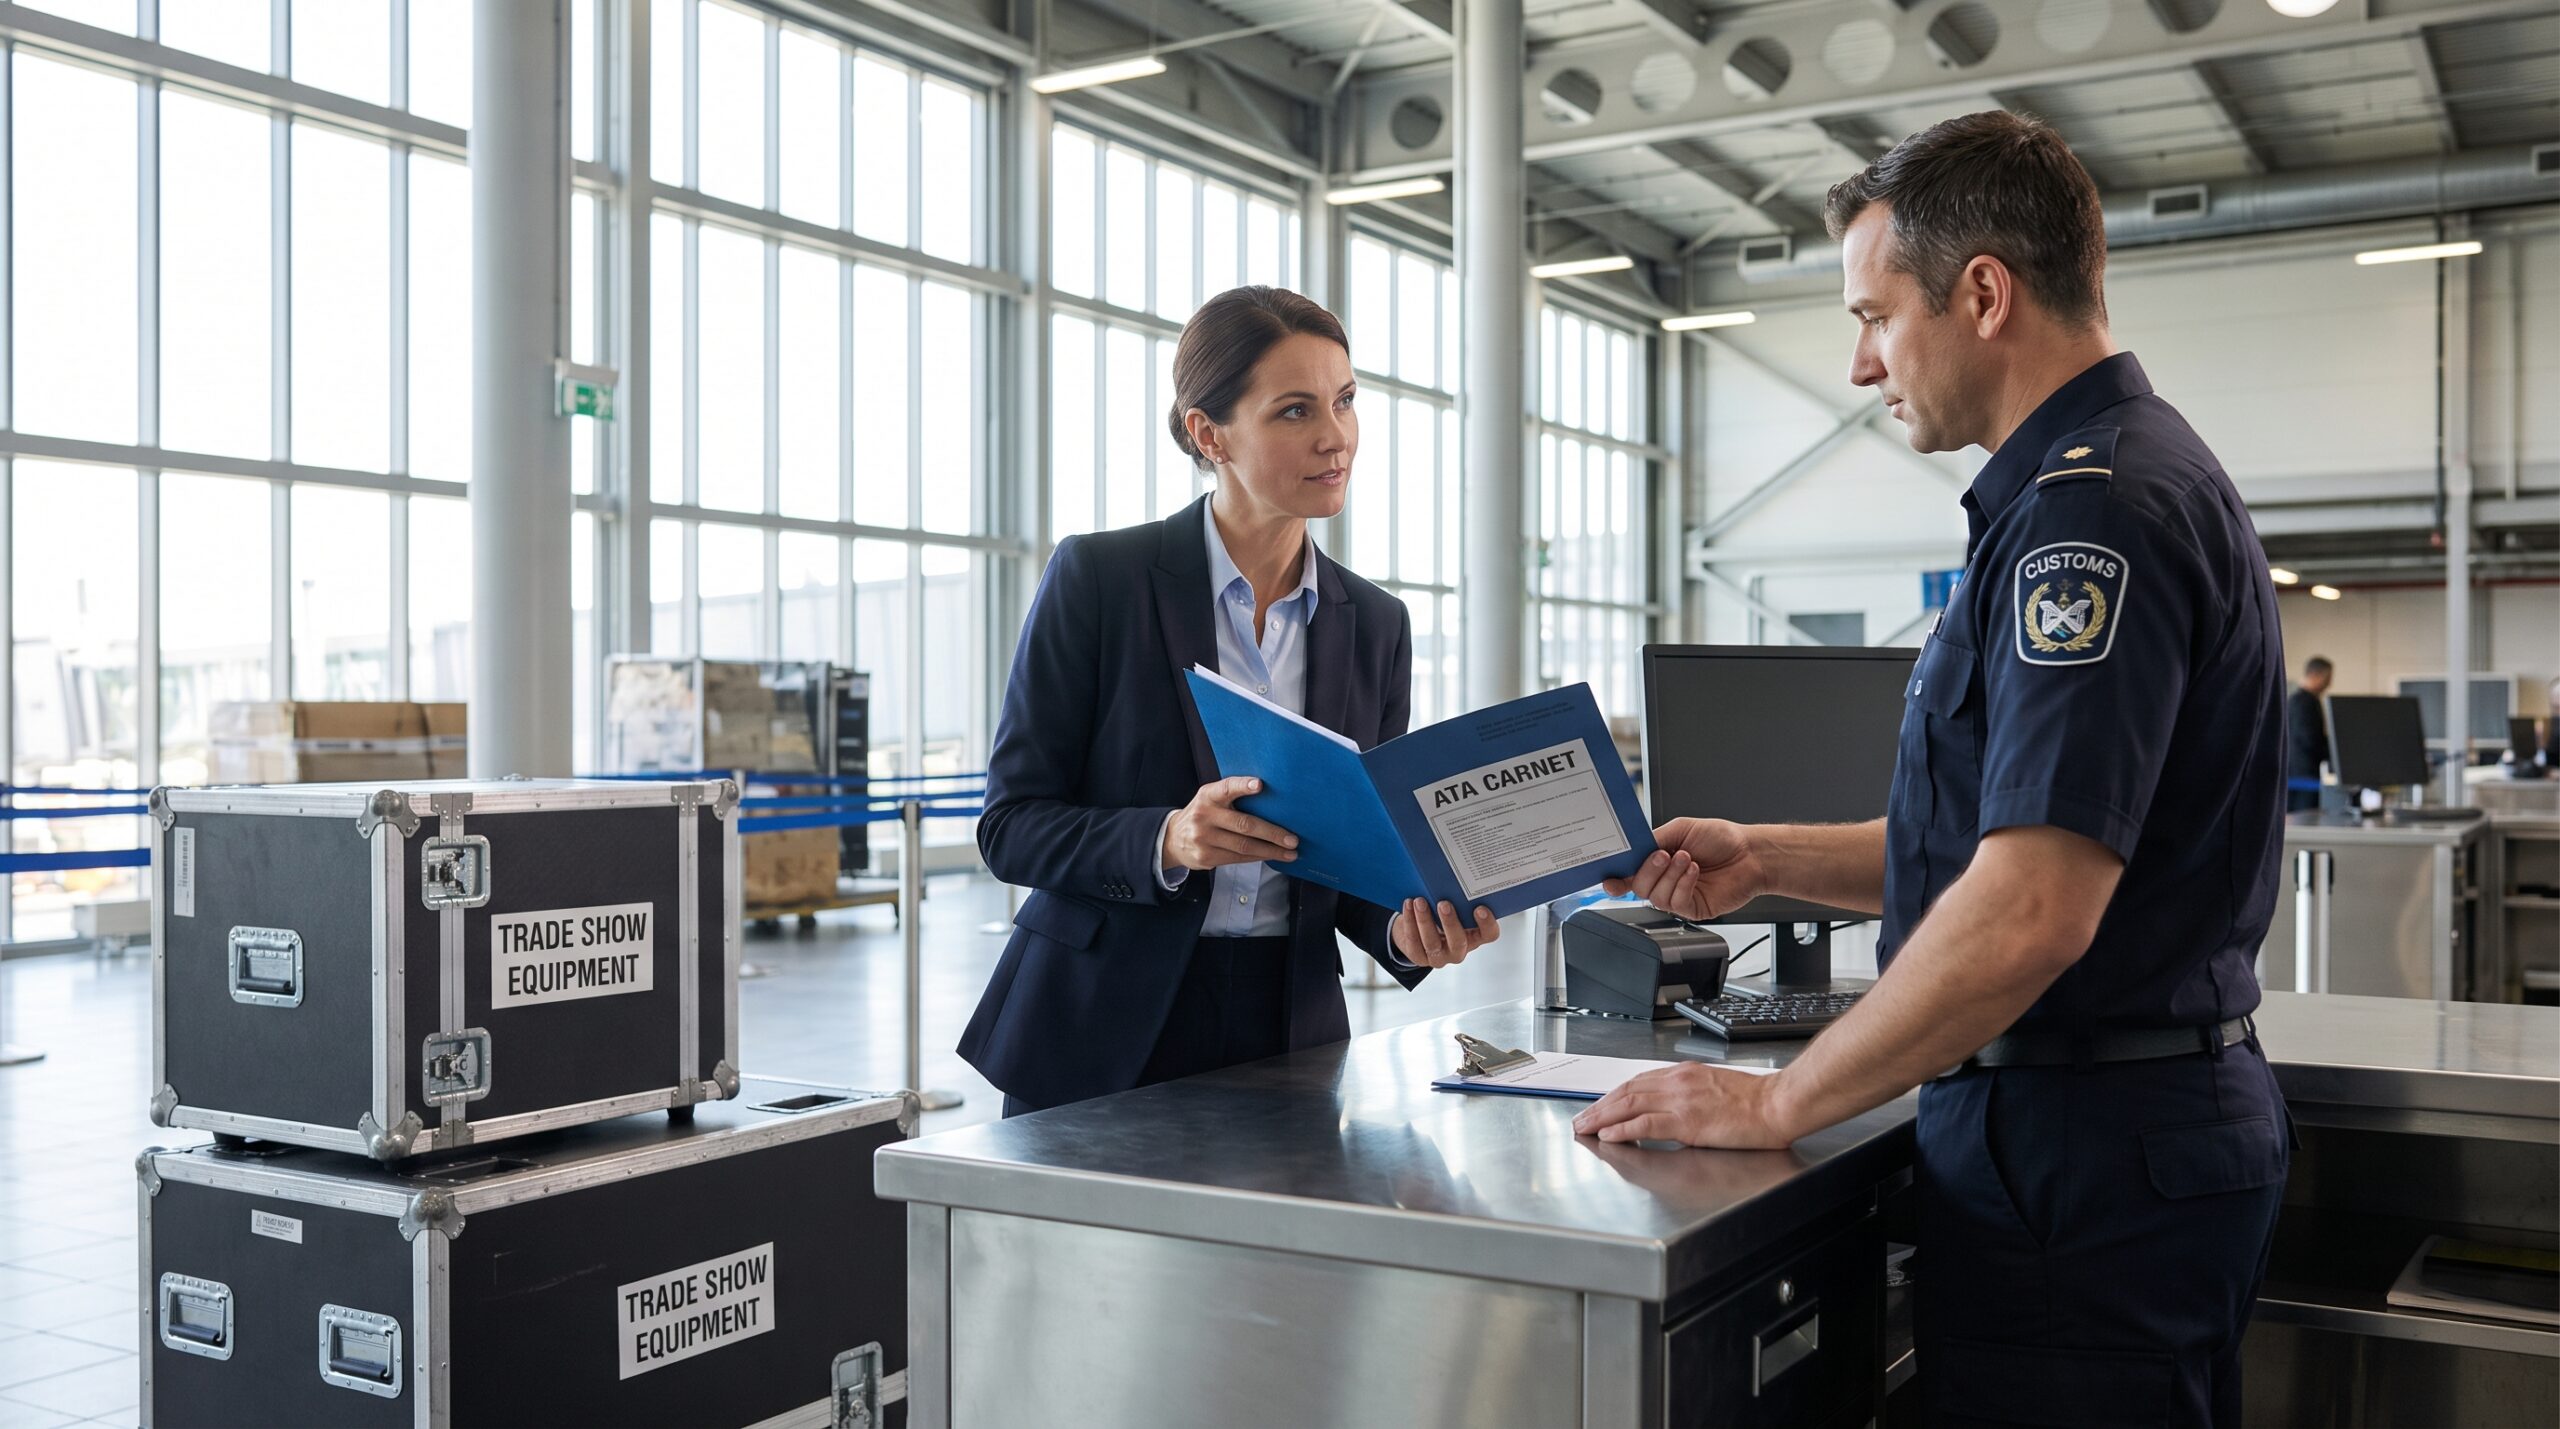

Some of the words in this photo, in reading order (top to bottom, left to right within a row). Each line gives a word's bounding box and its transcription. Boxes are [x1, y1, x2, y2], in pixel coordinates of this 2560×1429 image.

[2025, 553, 2117, 578] CUSTOMS
[1434, 779, 1479, 809] ATA
[1482, 750, 1577, 790] CARNET
[498, 919, 574, 954] TRADE
[581, 912, 647, 947] SHOW
[508, 954, 639, 996] EQUIPMENT
[625, 1274, 698, 1323] TRADE
[705, 1254, 767, 1299] SHOW
[636, 1297, 760, 1363] EQUIPMENT
